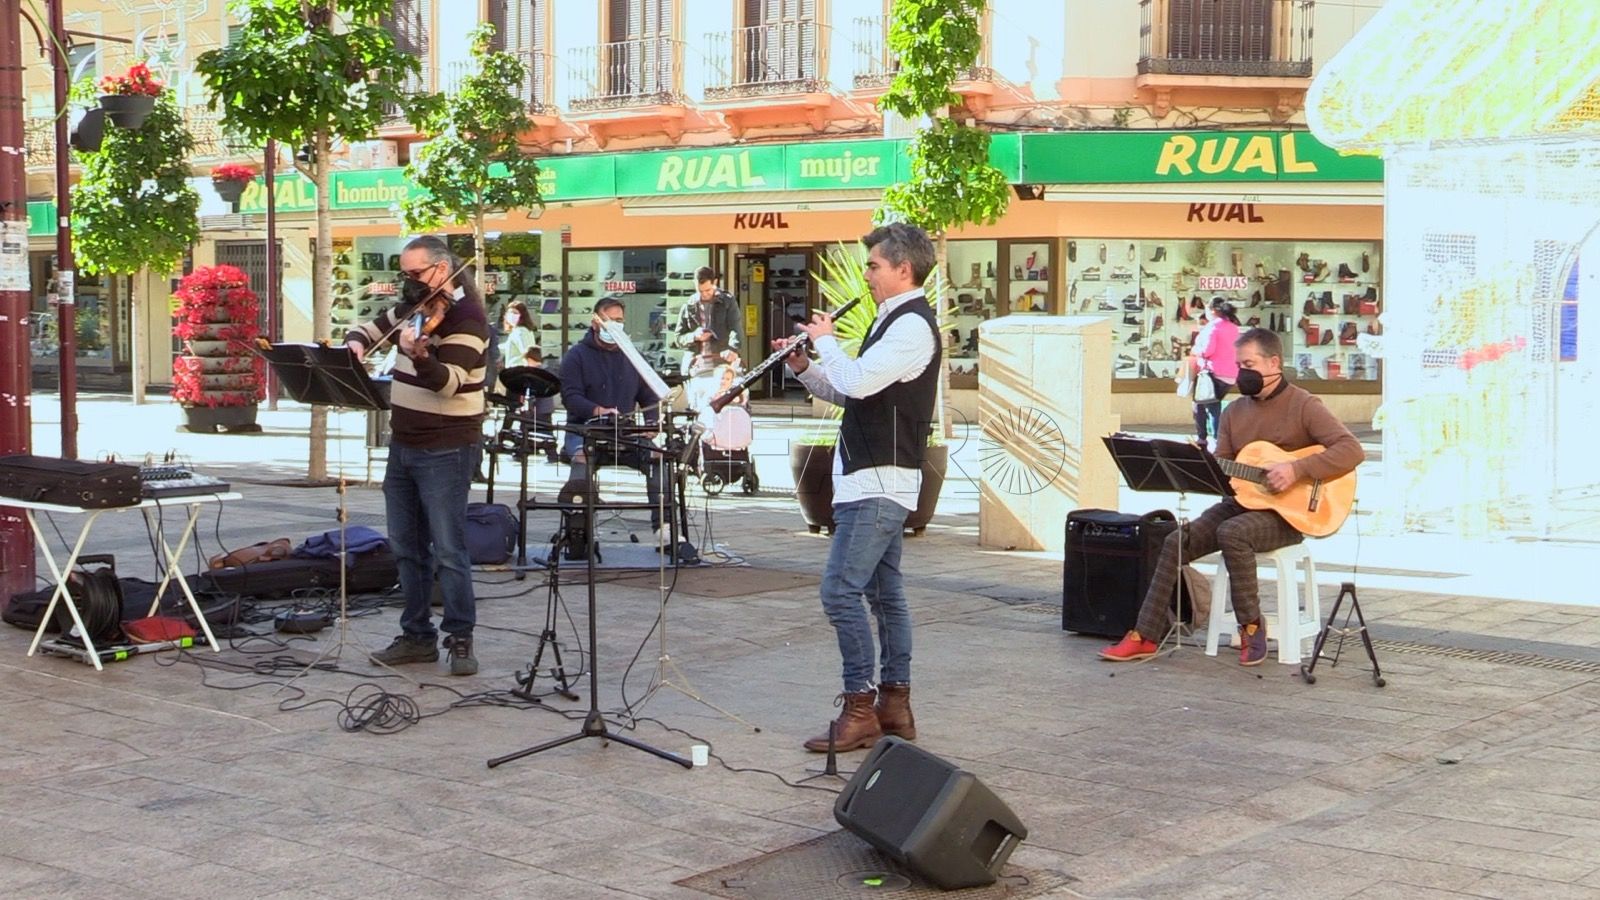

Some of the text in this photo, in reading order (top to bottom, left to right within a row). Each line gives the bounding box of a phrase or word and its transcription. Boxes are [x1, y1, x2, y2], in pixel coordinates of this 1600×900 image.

[800, 150, 881, 183] mujer
[1155, 132, 1318, 176] RUAL
[656, 150, 767, 192] RUAL
[337, 179, 408, 204] hombre
[734, 212, 789, 230] RUAL
[1187, 203, 1265, 223] RUAL
[1200, 277, 1247, 289] REBAJAS
